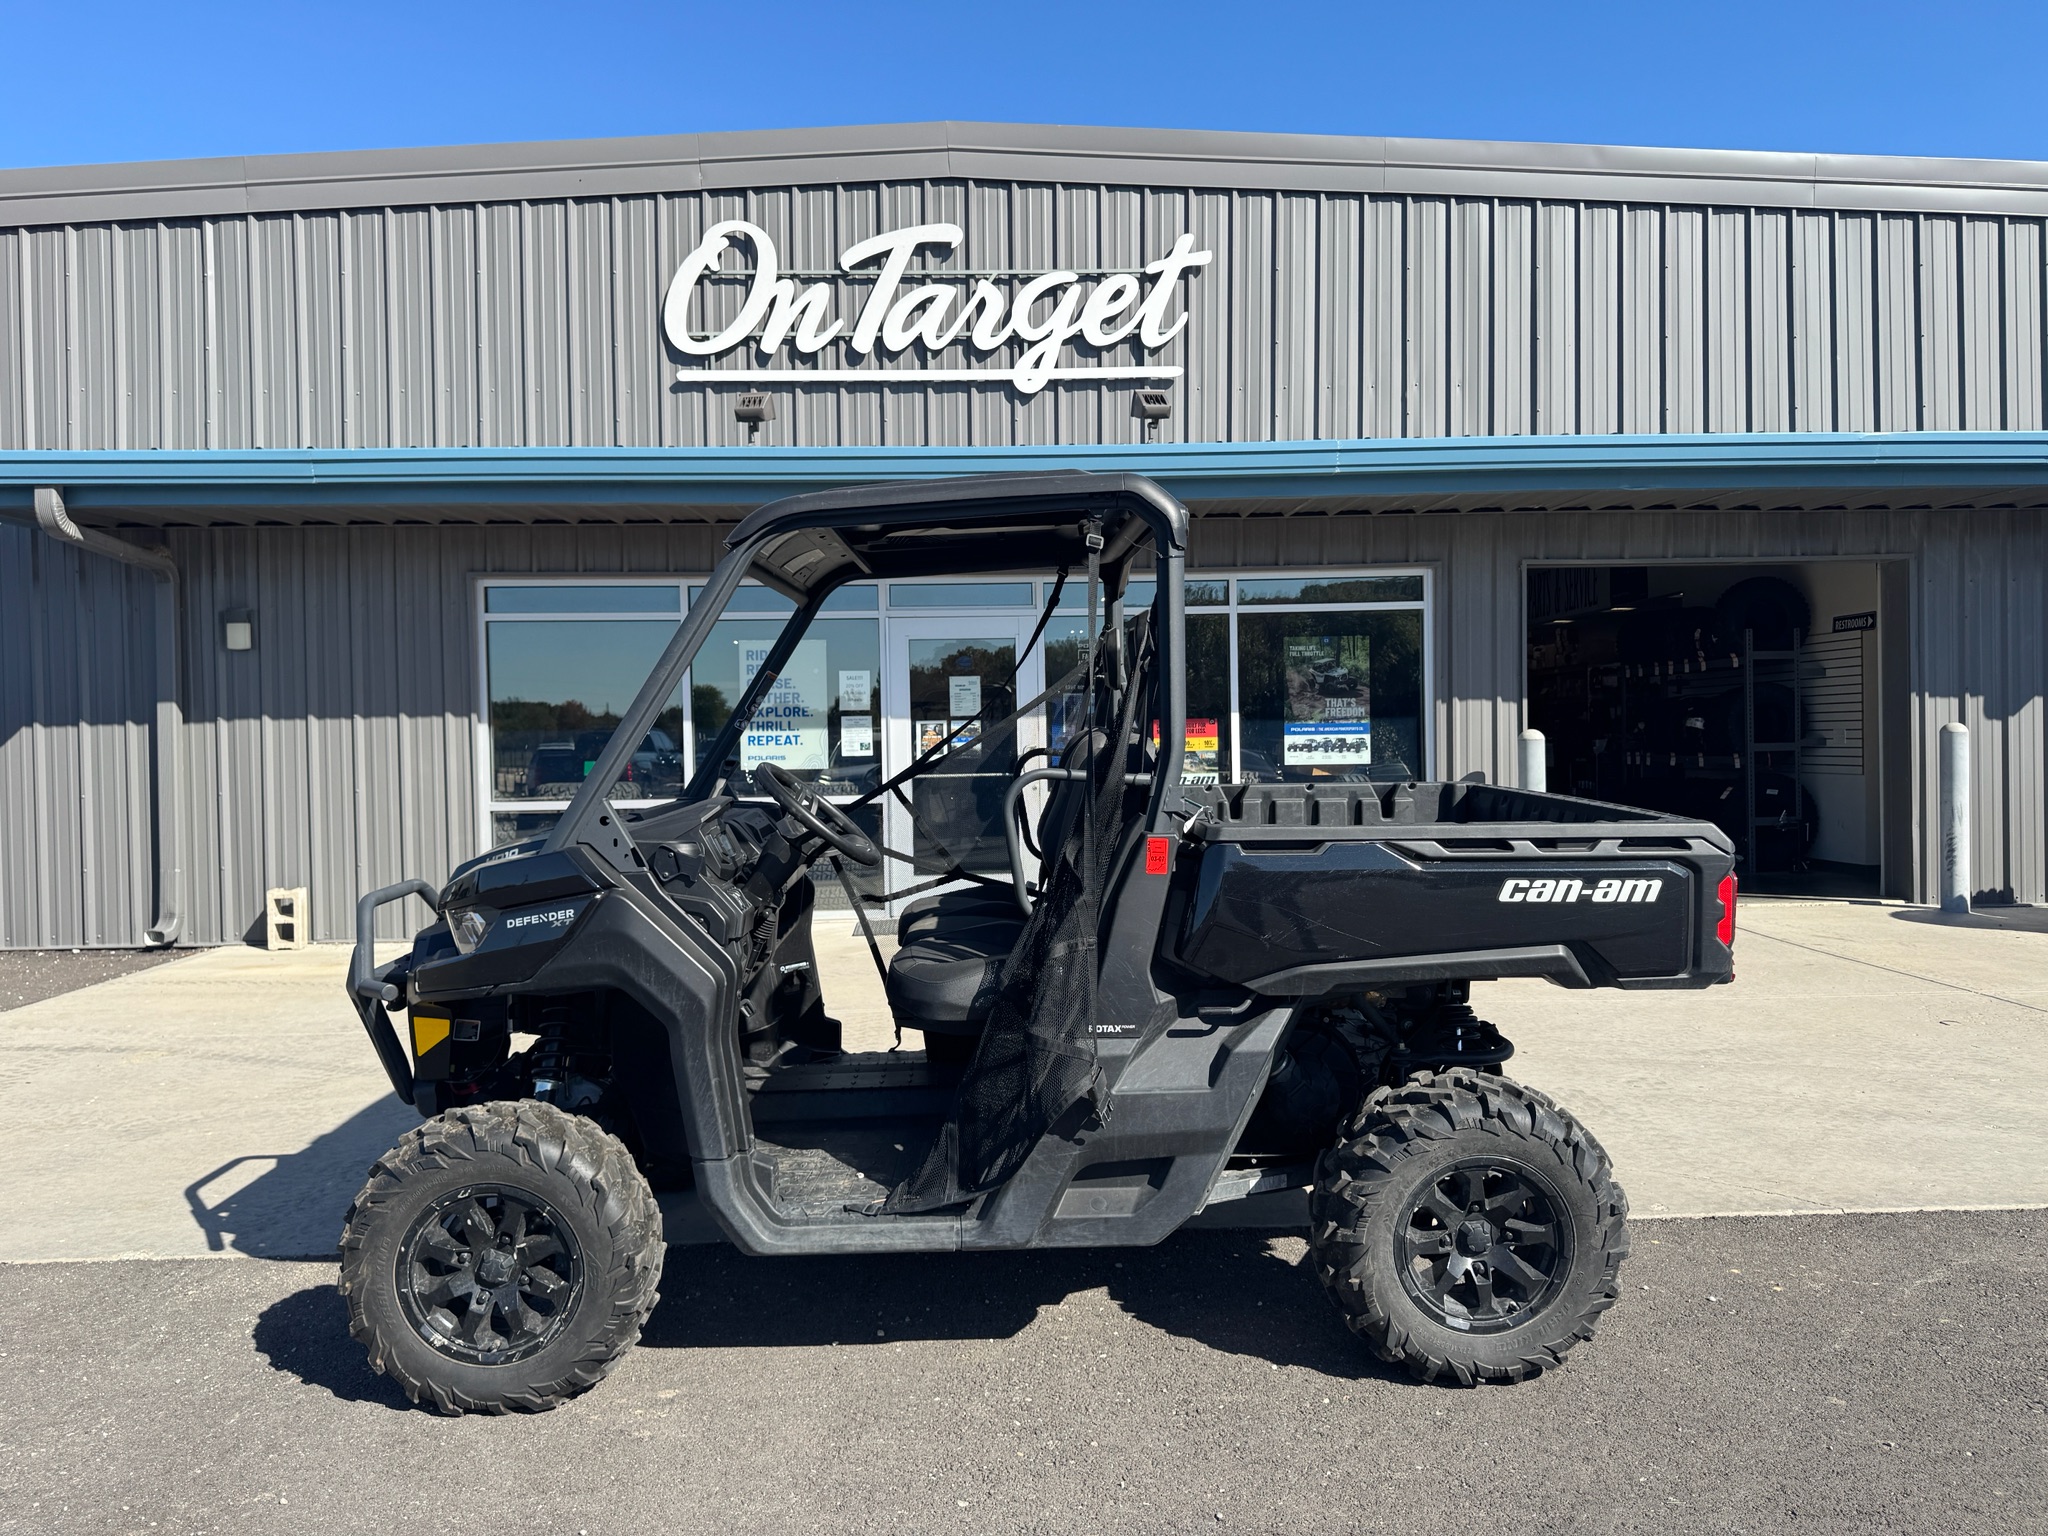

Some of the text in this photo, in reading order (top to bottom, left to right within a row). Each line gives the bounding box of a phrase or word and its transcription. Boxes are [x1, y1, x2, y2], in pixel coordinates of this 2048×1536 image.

[1835, 617, 1867, 630] RESTROOMS
[763, 692, 805, 704] THER.
[1325, 698, 1357, 708] THAT'S
[753, 706, 814, 718] XPLORE.
[1325, 707, 1365, 718] FREEDOM
[748, 721, 800, 732] THRILL.
[747, 734, 804, 746] REPEAT.
[1180, 775, 1216, 785] n-am
[1498, 879, 1664, 903] can-am
[506, 908, 575, 929] DEFENDER
[551, 917, 575, 928] XT
